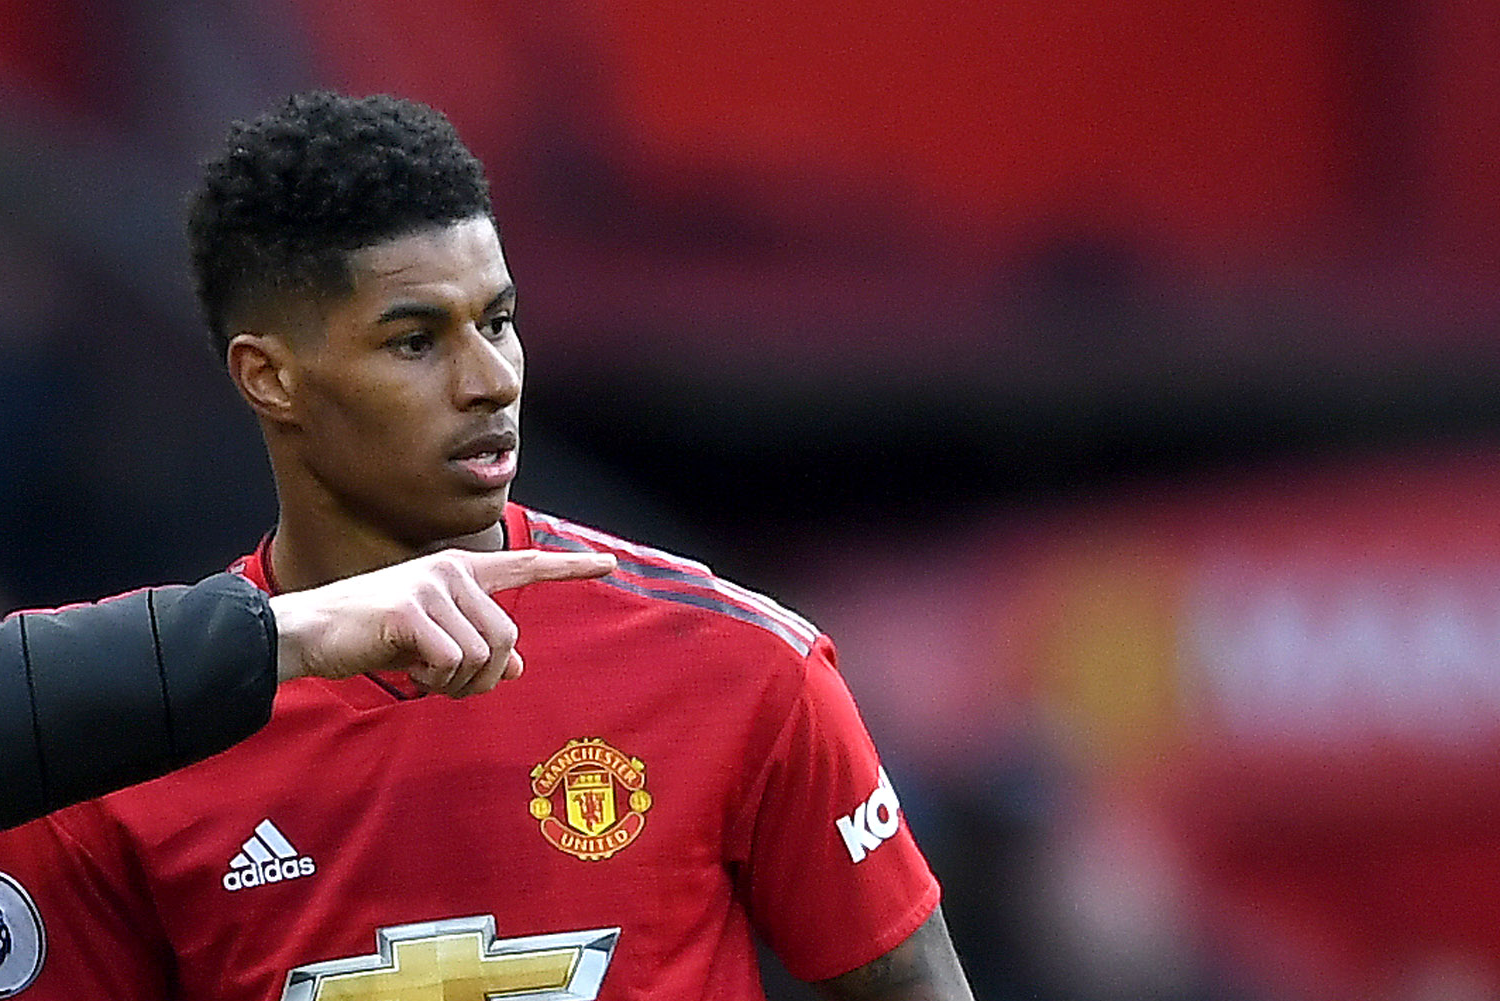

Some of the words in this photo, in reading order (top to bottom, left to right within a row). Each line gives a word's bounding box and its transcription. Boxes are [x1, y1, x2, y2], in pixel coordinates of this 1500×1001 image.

[539, 748, 638, 788] MANCHESTER
[835, 766, 900, 863] KO
[561, 829, 628, 852] UNITED
[223, 855, 316, 891] adidas
